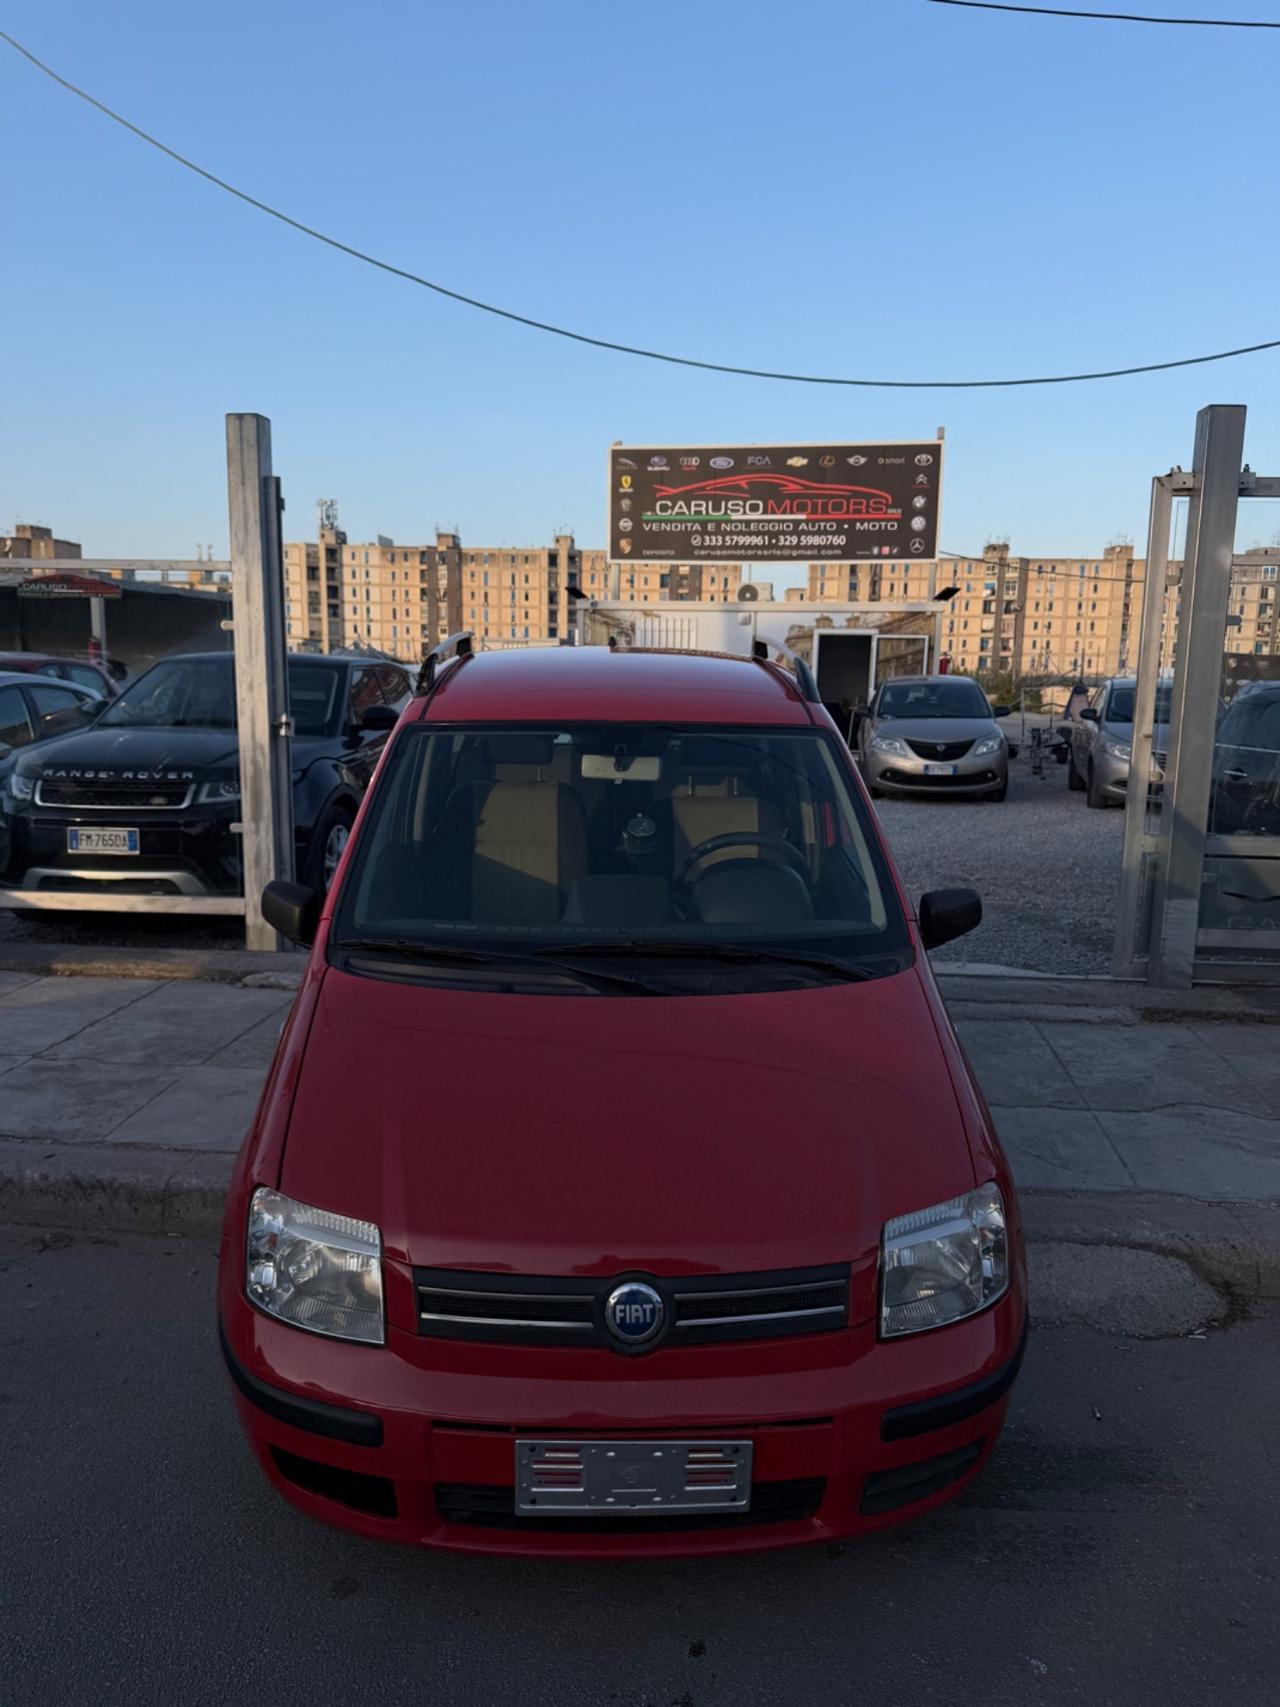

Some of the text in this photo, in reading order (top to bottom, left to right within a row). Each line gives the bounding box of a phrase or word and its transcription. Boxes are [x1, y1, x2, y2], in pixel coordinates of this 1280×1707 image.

[655, 500, 764, 516] CARUSO
[767, 498, 887, 515] MOTORS
[642, 521, 898, 532] VENDITA E NOLEGGIO AUTO MOTO
[702, 535, 847, 546] 333 5799961 329 5980760
[43, 769, 194, 779] RANGE ROVER
[615, 1303, 654, 1324] FIAT
